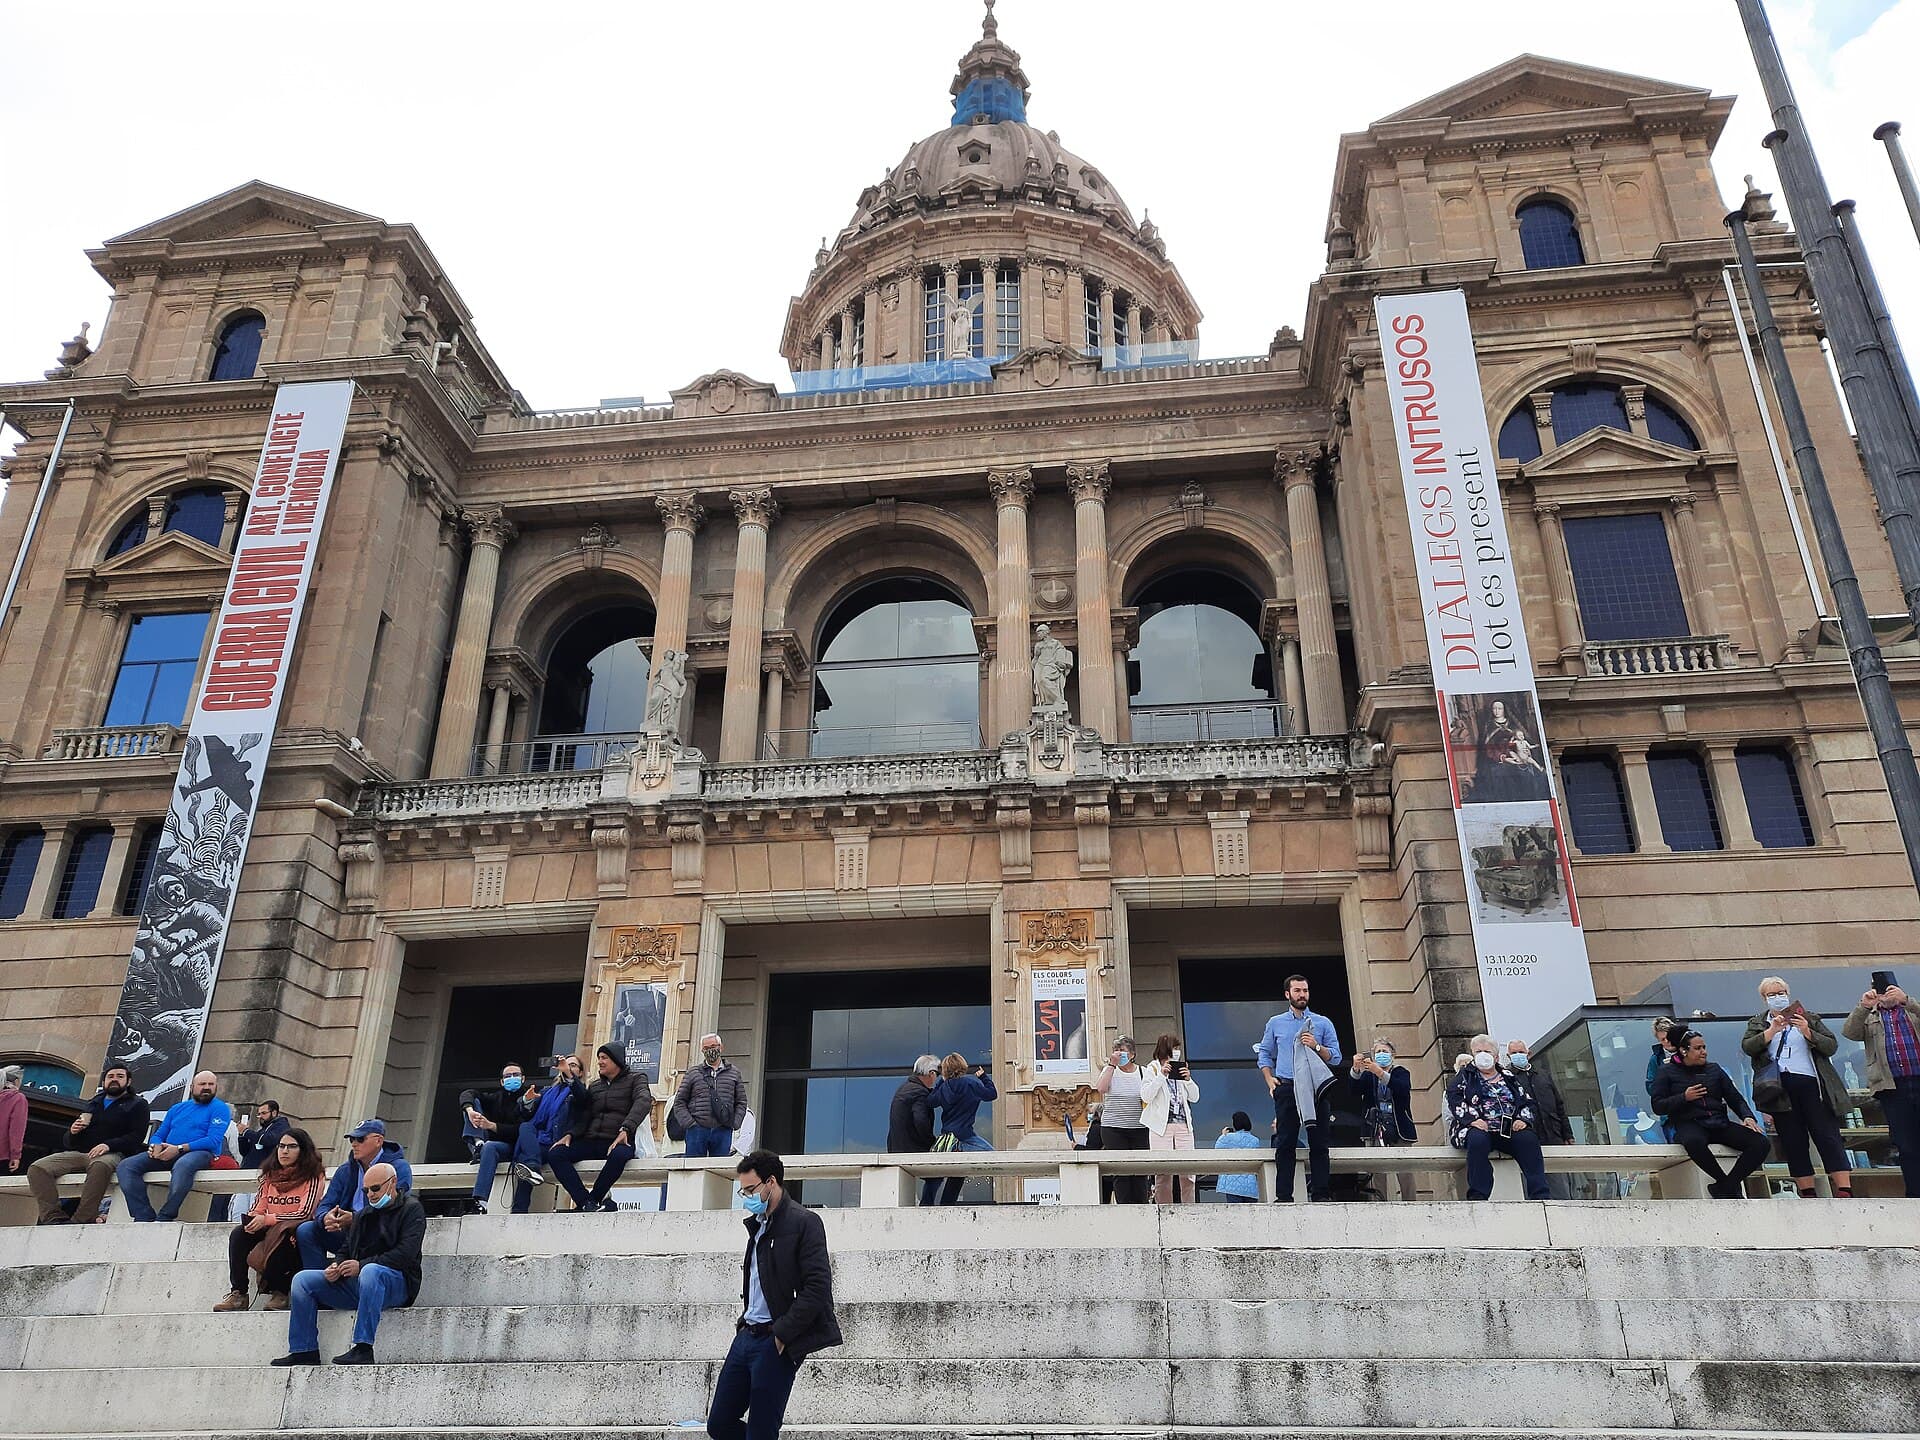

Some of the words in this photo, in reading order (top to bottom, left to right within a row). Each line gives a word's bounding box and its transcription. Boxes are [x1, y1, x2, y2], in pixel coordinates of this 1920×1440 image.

[1392, 314, 1447, 475] INTRUSOS
[255, 411, 305, 497] CONFLICTE
[283, 449, 330, 525] MEMÒRIA
[1455, 446, 1506, 566] present
[245, 500, 286, 535] ART,
[280, 527, 312, 535] I
[228, 541, 309, 606] CIVIL
[1418, 485, 1481, 675] DIÀLEGS
[1475, 574, 1505, 608] és
[201, 607, 293, 711] GUERRA
[1483, 617, 1517, 674] Tot
[1484, 954, 1538, 964] 13.11.2020
[1486, 966, 1531, 976] 7.11.2021
[268, 1196, 301, 1205] addas
[618, 1202, 641, 1210] CIONAL
